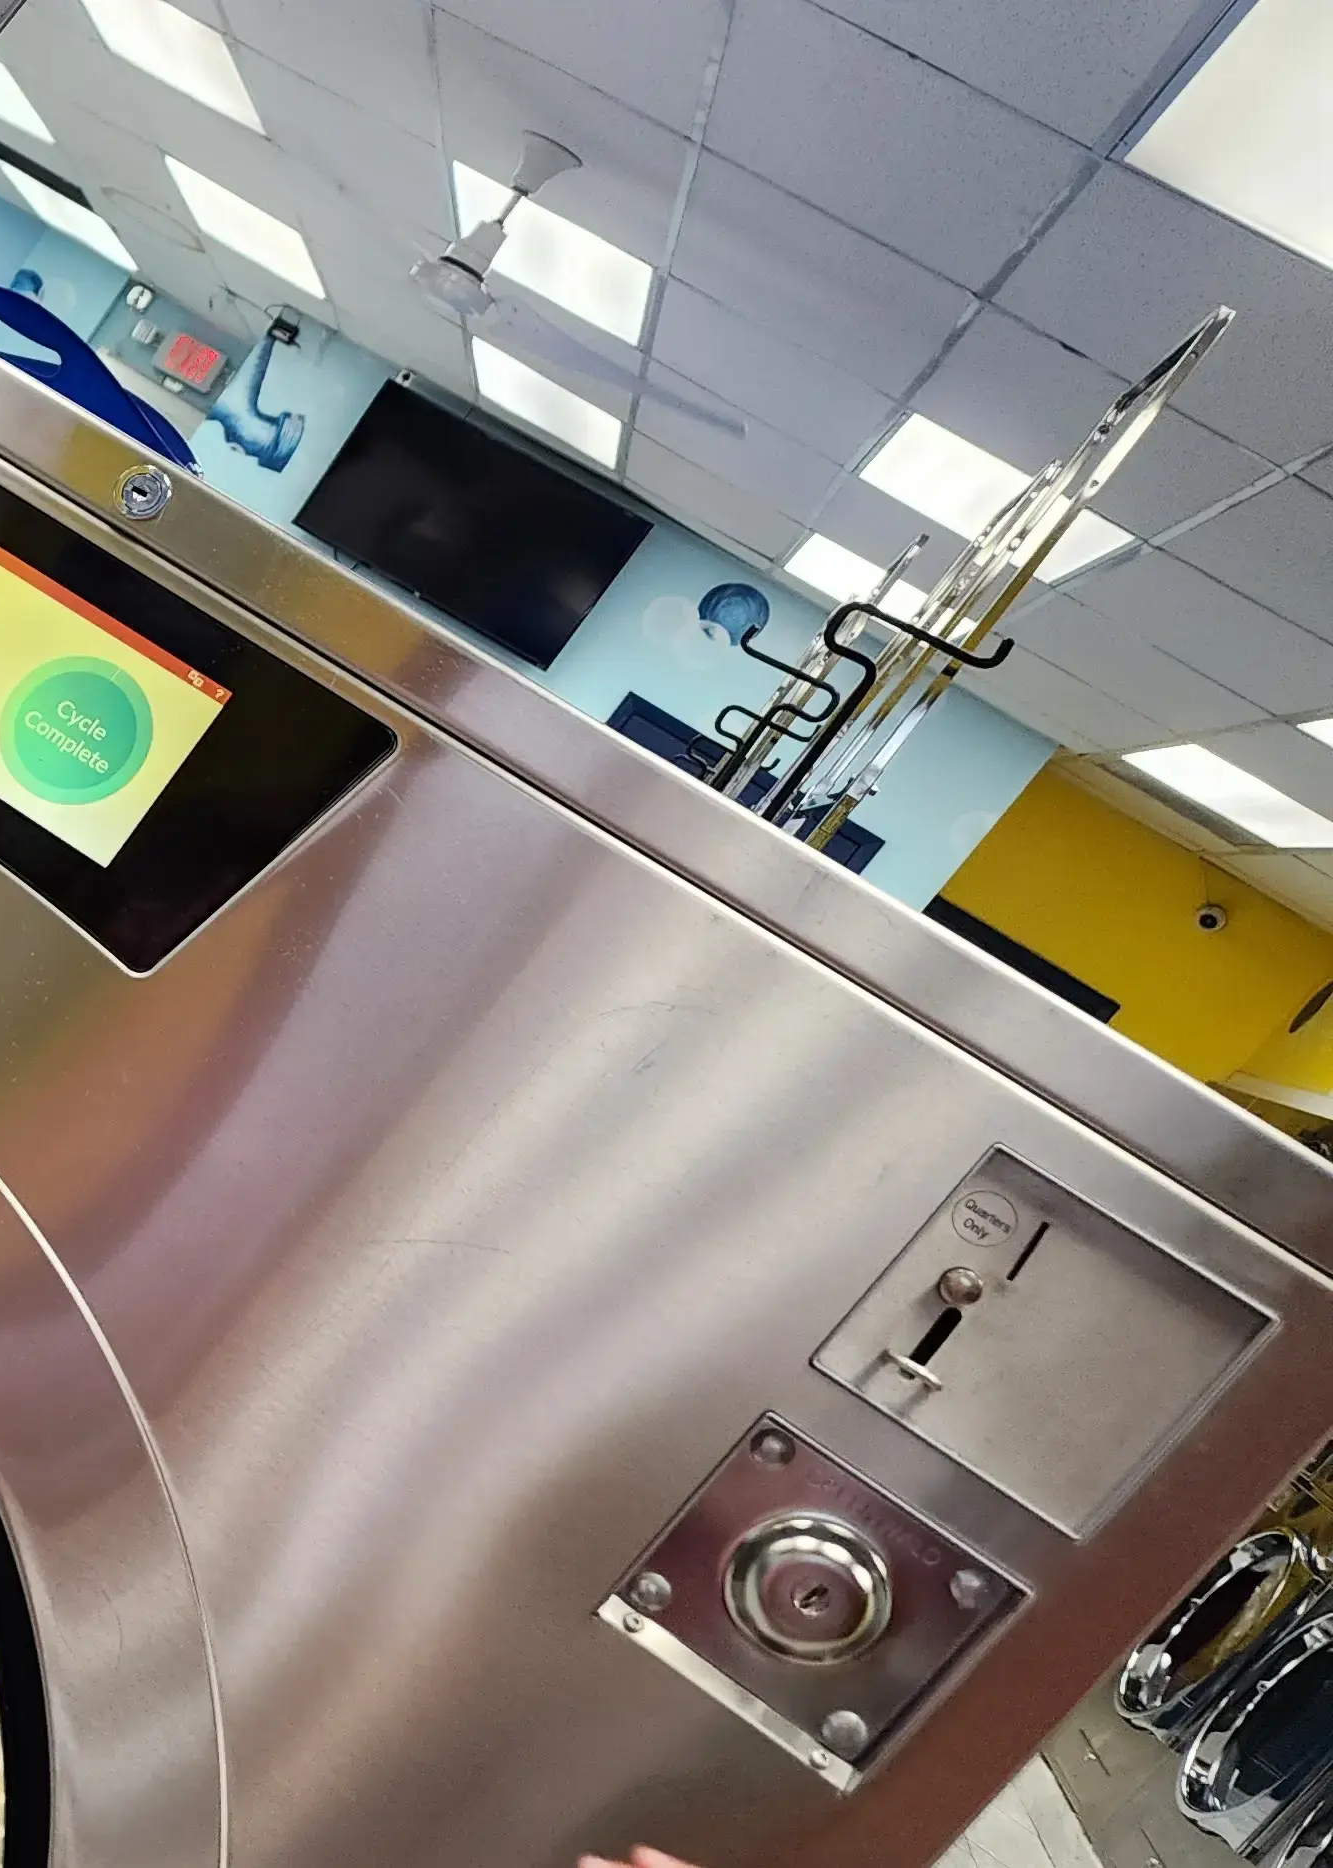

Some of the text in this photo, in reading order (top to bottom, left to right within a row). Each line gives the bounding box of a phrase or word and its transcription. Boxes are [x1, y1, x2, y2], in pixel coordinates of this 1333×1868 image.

[56, 700, 107, 742] Cycle
[24, 710, 110, 775] Complete
[963, 1217, 990, 1240] Only
[965, 1199, 1011, 1235] Quarters
